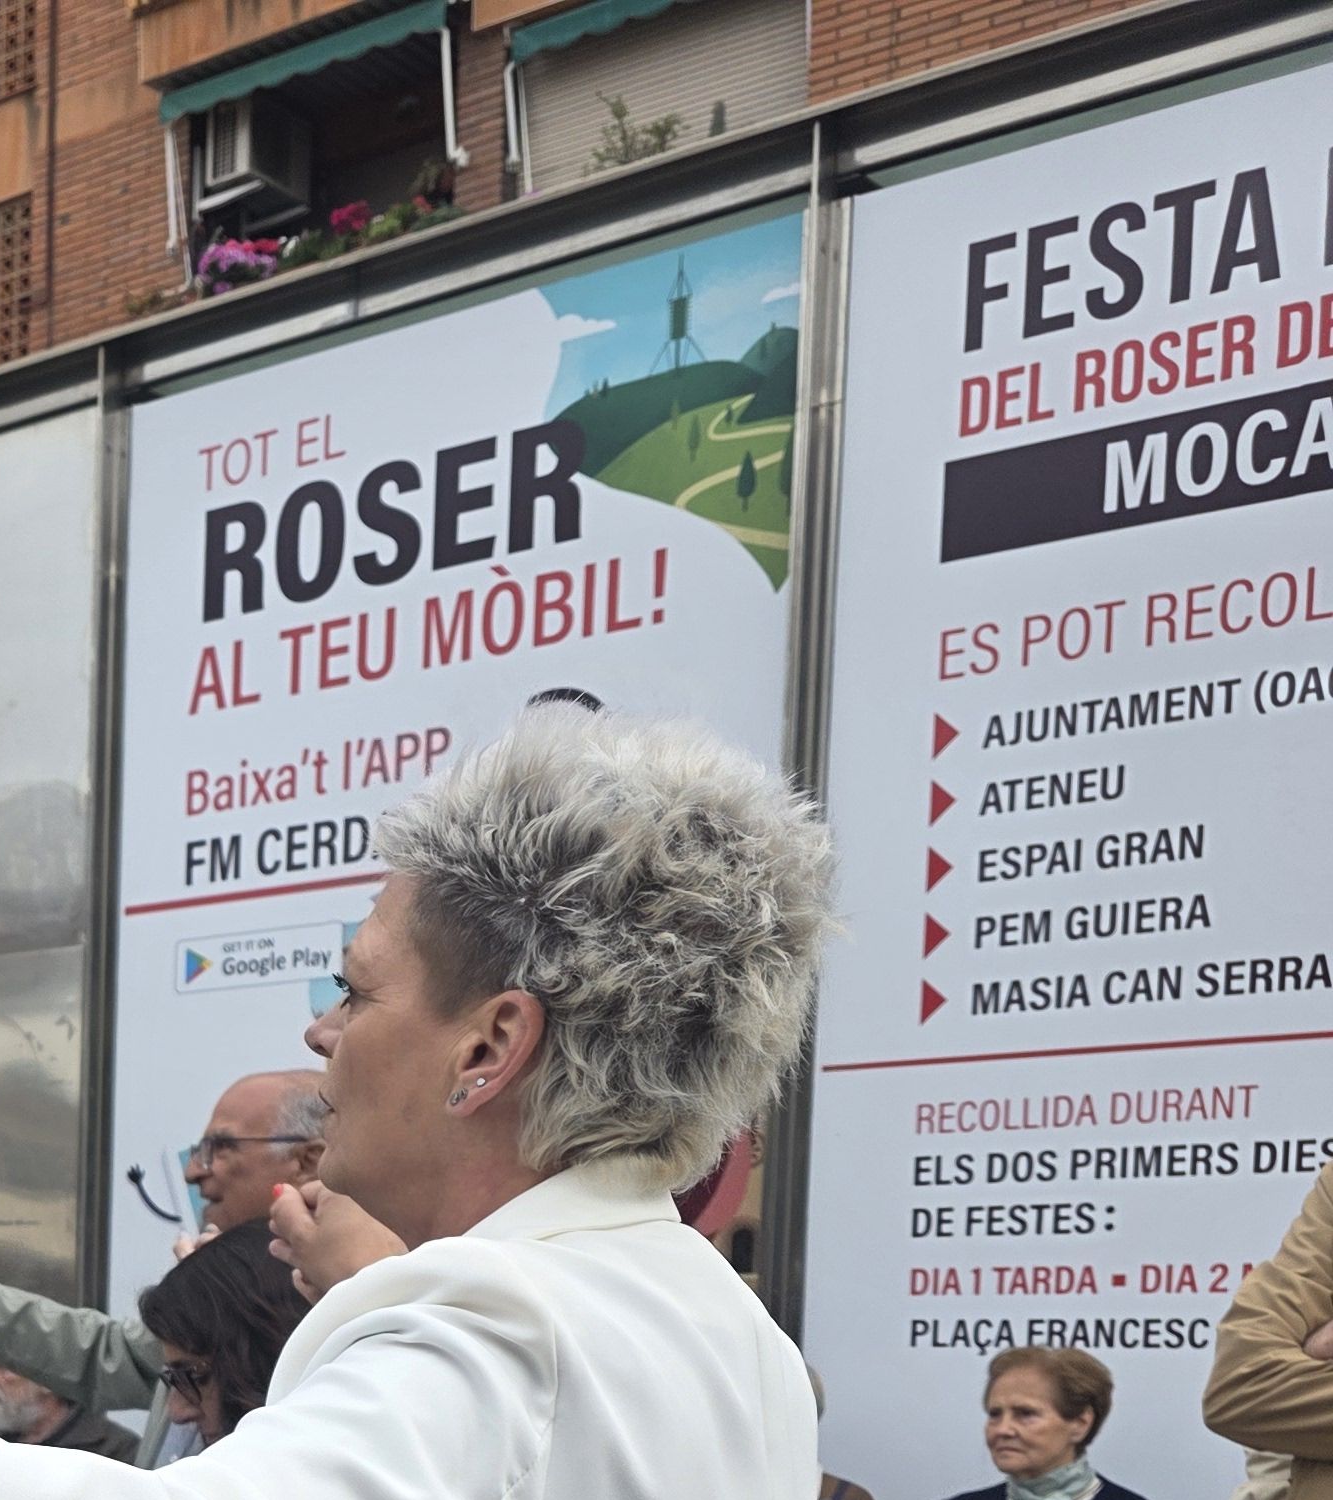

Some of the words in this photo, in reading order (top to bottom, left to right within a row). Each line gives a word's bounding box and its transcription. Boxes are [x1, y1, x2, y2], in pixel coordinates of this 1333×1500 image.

[963, 166, 1281, 353] FESTA
[958, 362, 1055, 438] DEL
[1073, 314, 1255, 413] ROSER
[199, 429, 279, 490] TOT
[295, 414, 347, 468] EL
[203, 418, 586, 623] ROSER
[188, 639, 261, 716] AL
[280, 606, 396, 695] TEU
[422, 547, 668, 670] MÒBIL!
[938, 622, 1000, 681] ES
[1021, 600, 1127, 667] POT
[981, 678, 1241, 750] AJUNTAMENT
[1253, 663, 1333, 715] (OA
[186, 748, 329, 816] Baixa't
[342, 726, 453, 791] l'APP
[978, 764, 1126, 817] ATENEU
[186, 834, 241, 886] FM
[977, 838, 1083, 883] ESPAI
[1095, 824, 1205, 870] GRAN
[222, 939, 243, 953] GET
[245, 938, 254, 951] IT
[256, 937, 275, 950] ON
[973, 909, 1052, 950] PEM
[1064, 893, 1212, 941] GUIERA
[222, 950, 286, 977] Google
[292, 947, 331, 970] Play
[971, 973, 1091, 1016] MASIA
[1102, 965, 1183, 1006] CAN
[915, 1094, 1098, 1135] RECOLLIDA
[1109, 1084, 1259, 1125] DURANT
[913, 1153, 975, 1187] ELS
[986, 1149, 1058, 1184] DOS
[1070, 1142, 1239, 1181] PRIMERS
[911, 1206, 955, 1238] DE
[909, 1266, 961, 1297] DIA
[971, 1267, 982, 1296] 1
[992, 1265, 1099, 1297] TARDA
[1139, 1263, 1198, 1295] DIA
[1208, 1263, 1229, 1294] 2
[909, 1318, 1016, 1356] PLAÇA
[1026, 1318, 1210, 1350] FRANCESC
